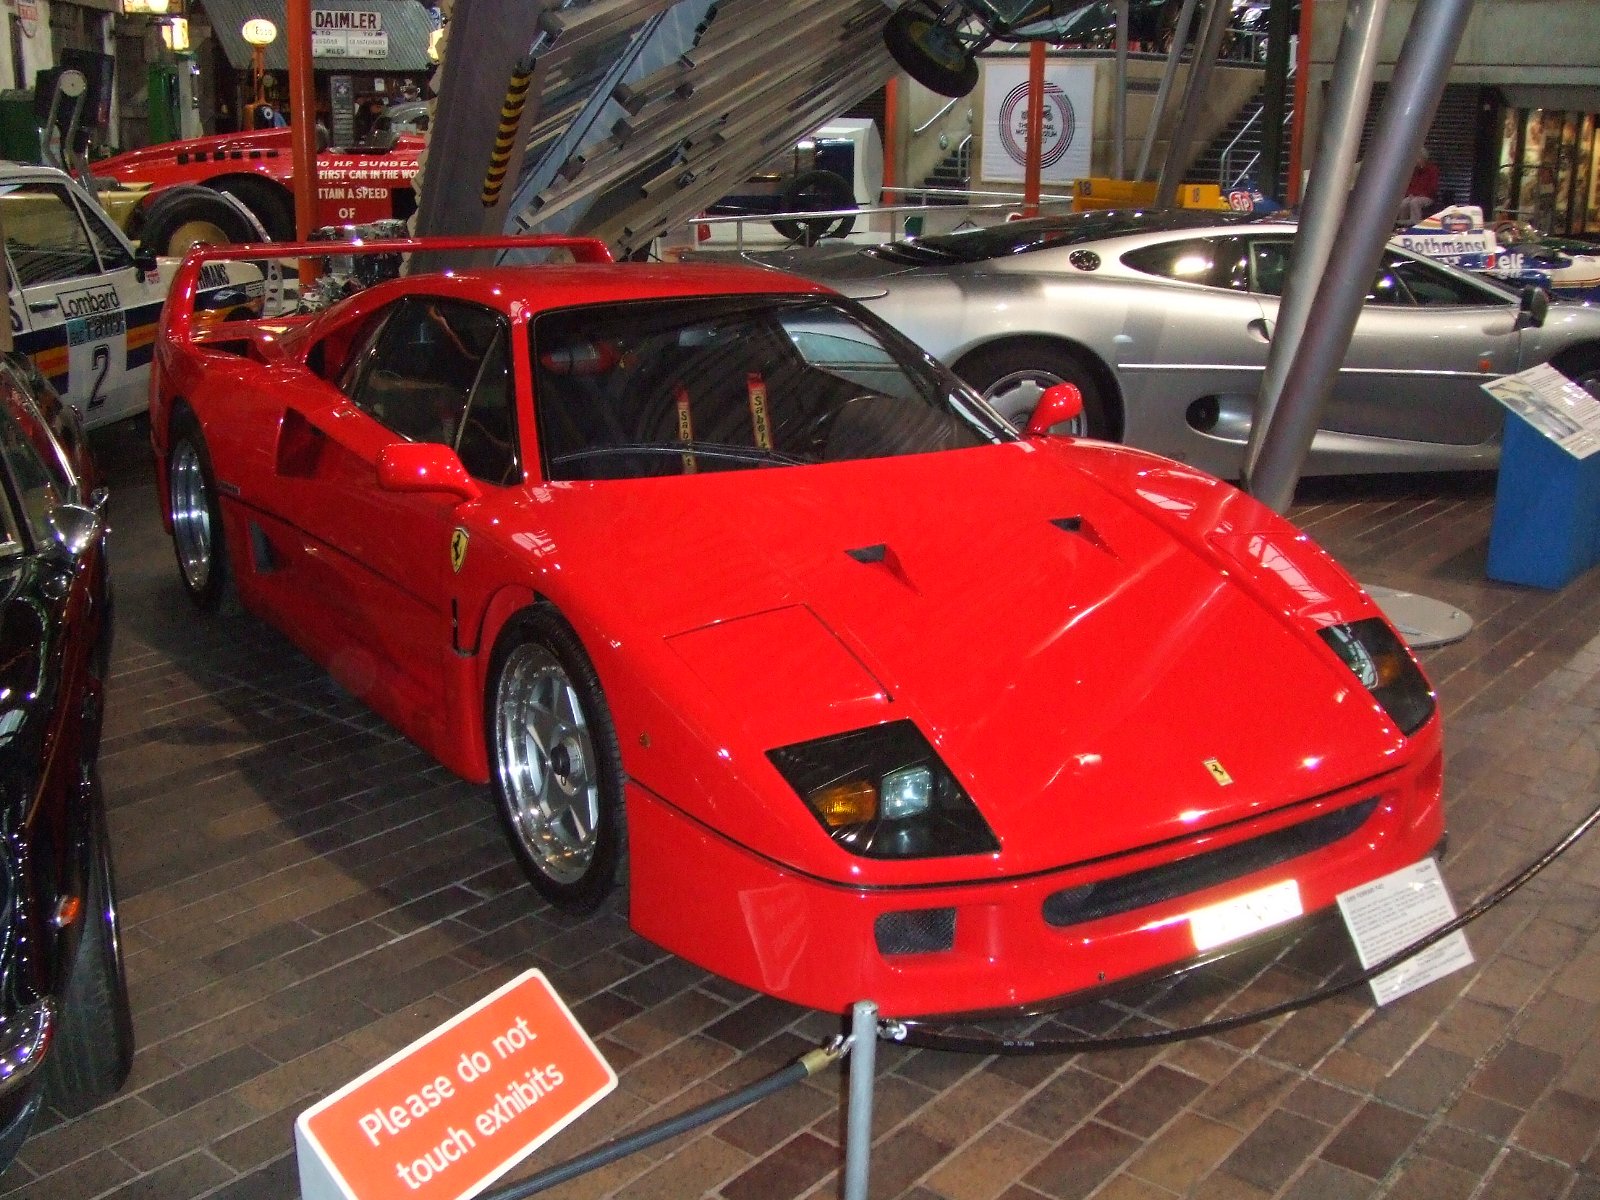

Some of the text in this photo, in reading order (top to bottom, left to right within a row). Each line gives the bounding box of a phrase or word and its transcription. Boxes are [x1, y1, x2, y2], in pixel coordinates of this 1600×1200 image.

[315, 11, 377, 29] DAIMLER
[319, 169, 420, 180] FIRST CAR IN THE WO
[347, 187, 354, 199] A
[356, 188, 388, 199] SPEED
[1078, 180, 1092, 196] 18
[338, 208, 356, 219] OF
[1402, 237, 1479, 255] Rothmans
[1501, 253, 1526, 269] elf
[58, 287, 120, 318] Lombard
[86, 310, 124, 341] rally
[88, 343, 111, 409] 2
[754, 395, 768, 449] Sabelt
[680, 410, 692, 467] Sabt
[358, 1015, 538, 1147] Please do not
[395, 1062, 565, 1190] touch exhibits
